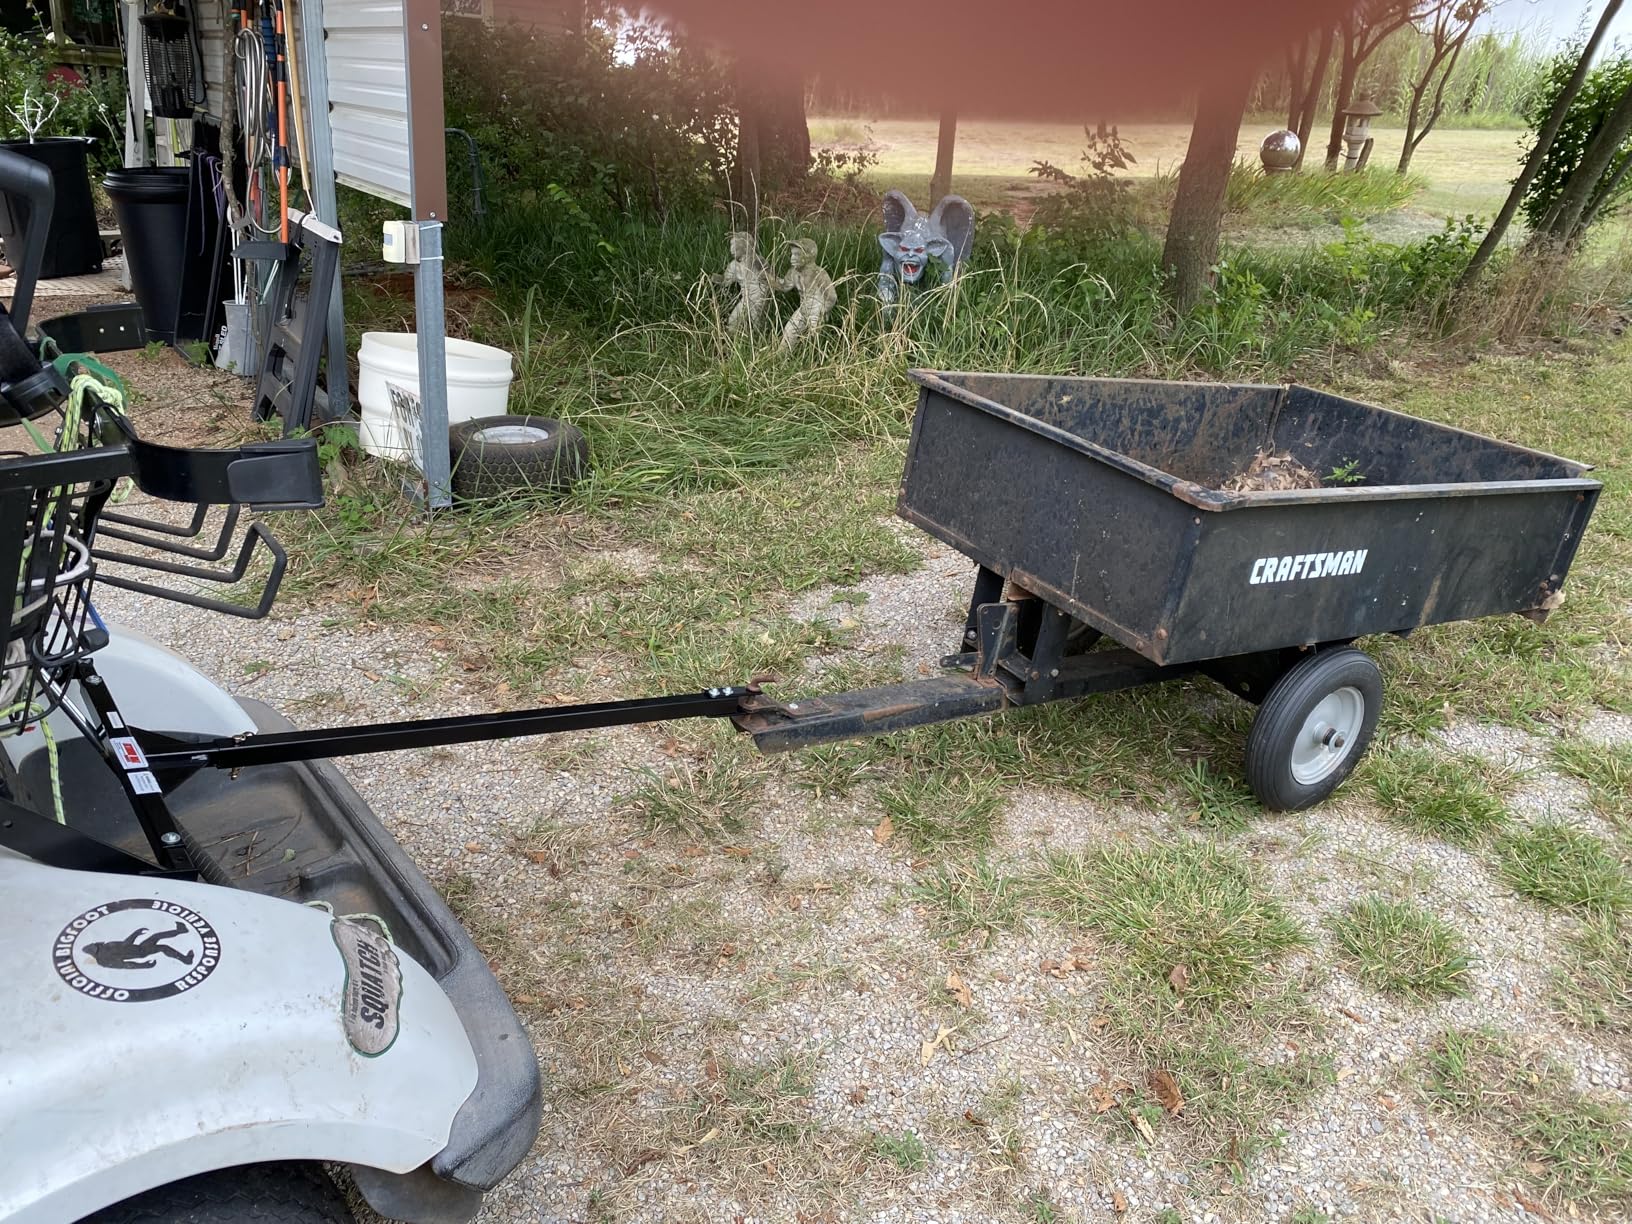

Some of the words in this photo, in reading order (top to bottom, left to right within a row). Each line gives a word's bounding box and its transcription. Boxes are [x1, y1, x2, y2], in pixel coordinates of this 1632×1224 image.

[1250, 549, 1368, 584] CRAFTSMAN
[56, 905, 110, 957] BIGFOOT
[151, 900, 211, 934] VEHICLE
[56, 960, 130, 1001] OFFICIAL
[174, 936, 218, 991] RESPONSE
[357, 938, 389, 1029] SQUATCH
